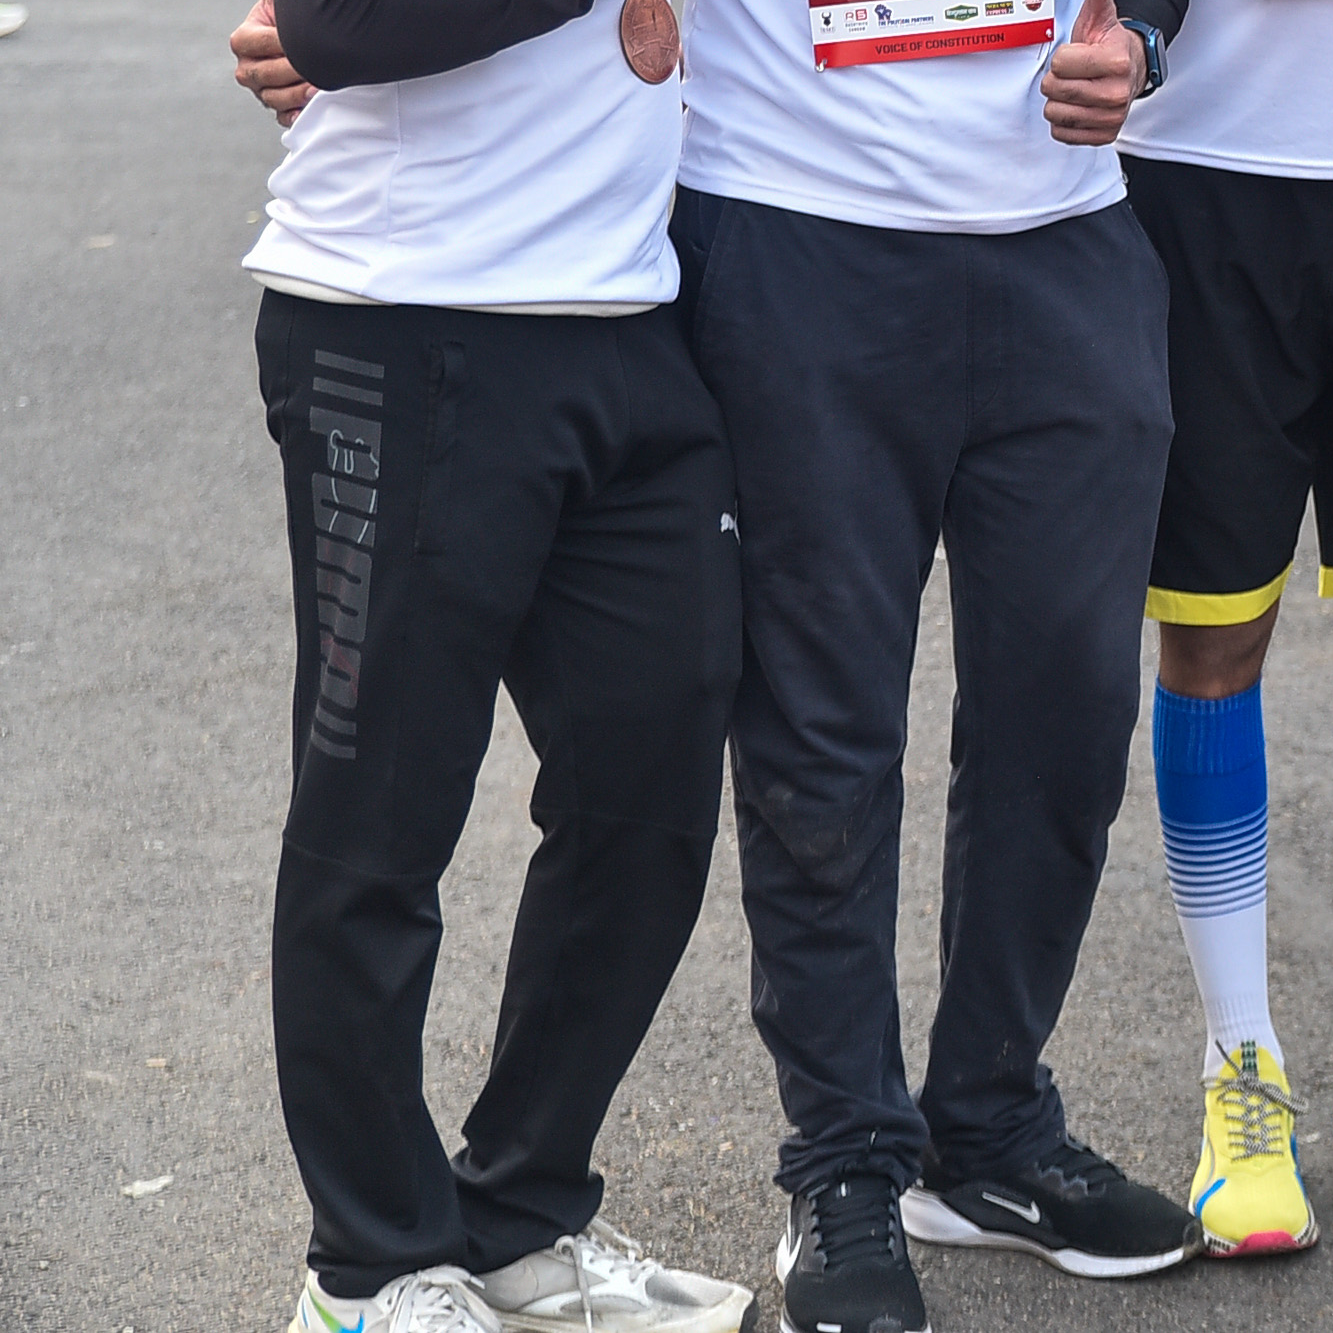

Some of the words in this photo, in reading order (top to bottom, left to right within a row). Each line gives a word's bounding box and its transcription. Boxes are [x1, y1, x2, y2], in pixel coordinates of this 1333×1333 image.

[875, 45, 908, 55] VOICE
[910, 42, 923, 51] OF
[925, 32, 1005, 50] CONSTITUTION
